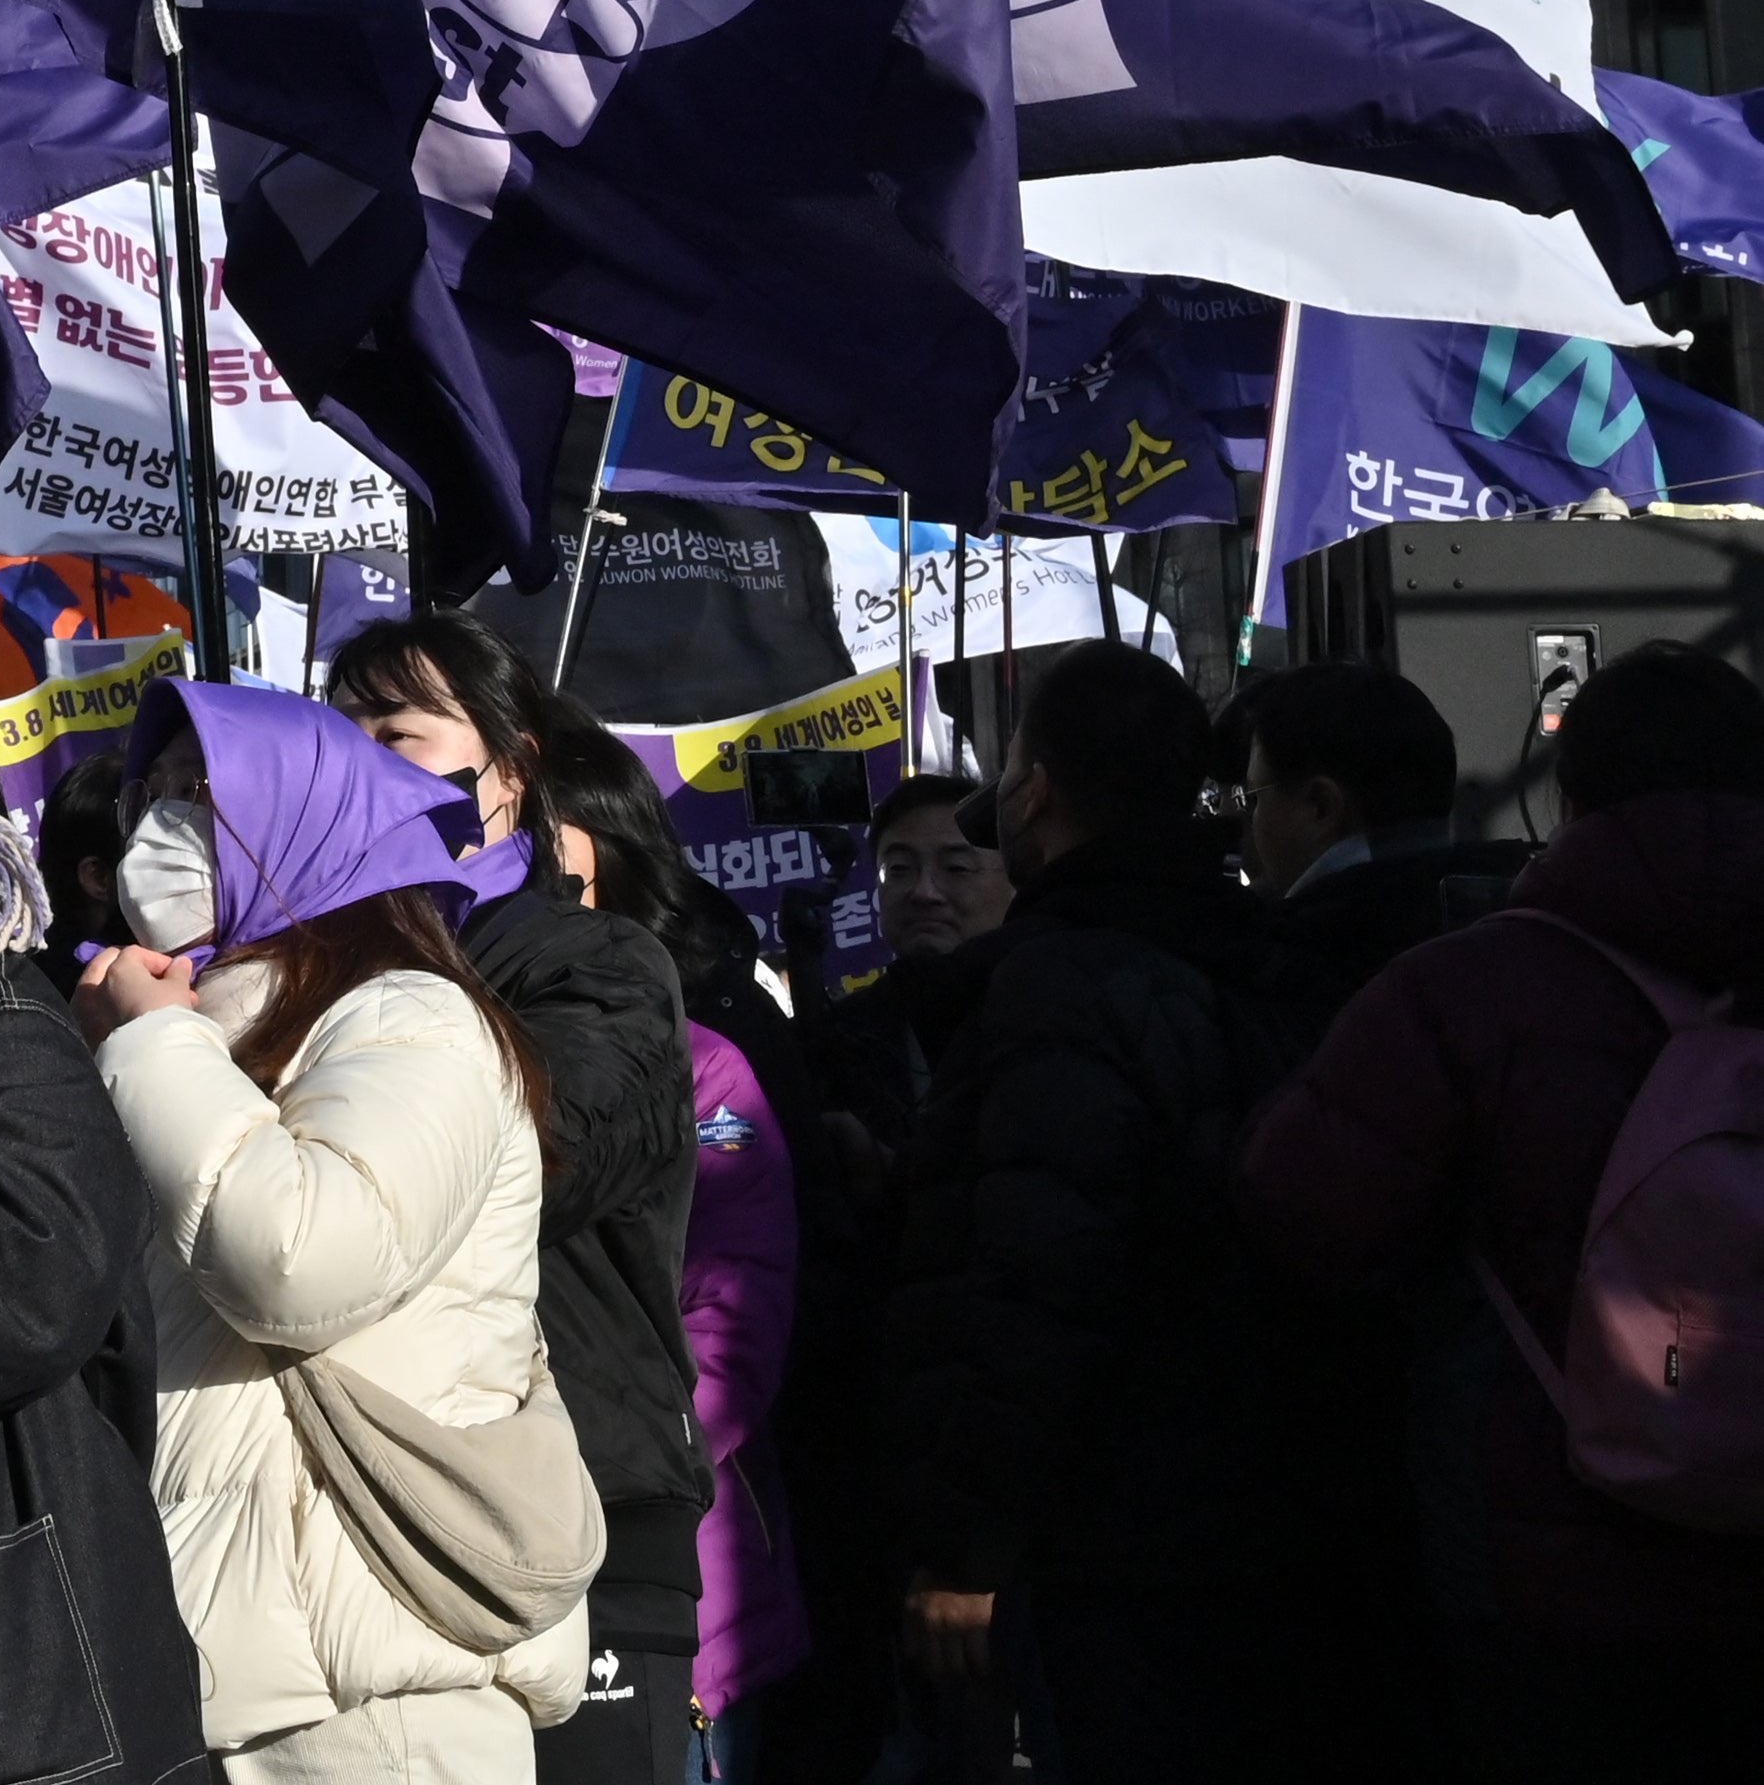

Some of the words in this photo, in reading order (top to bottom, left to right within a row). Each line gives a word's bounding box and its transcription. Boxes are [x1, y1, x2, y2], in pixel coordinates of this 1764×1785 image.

[55, 293, 157, 369] 없는
[24, 412, 338, 518] 한국여성애인연합
[591, 527, 782, 571] 수원여성의전화
[1, 708, 44, 746] 3.8
[774, 694, 884, 750] 세계여성의
